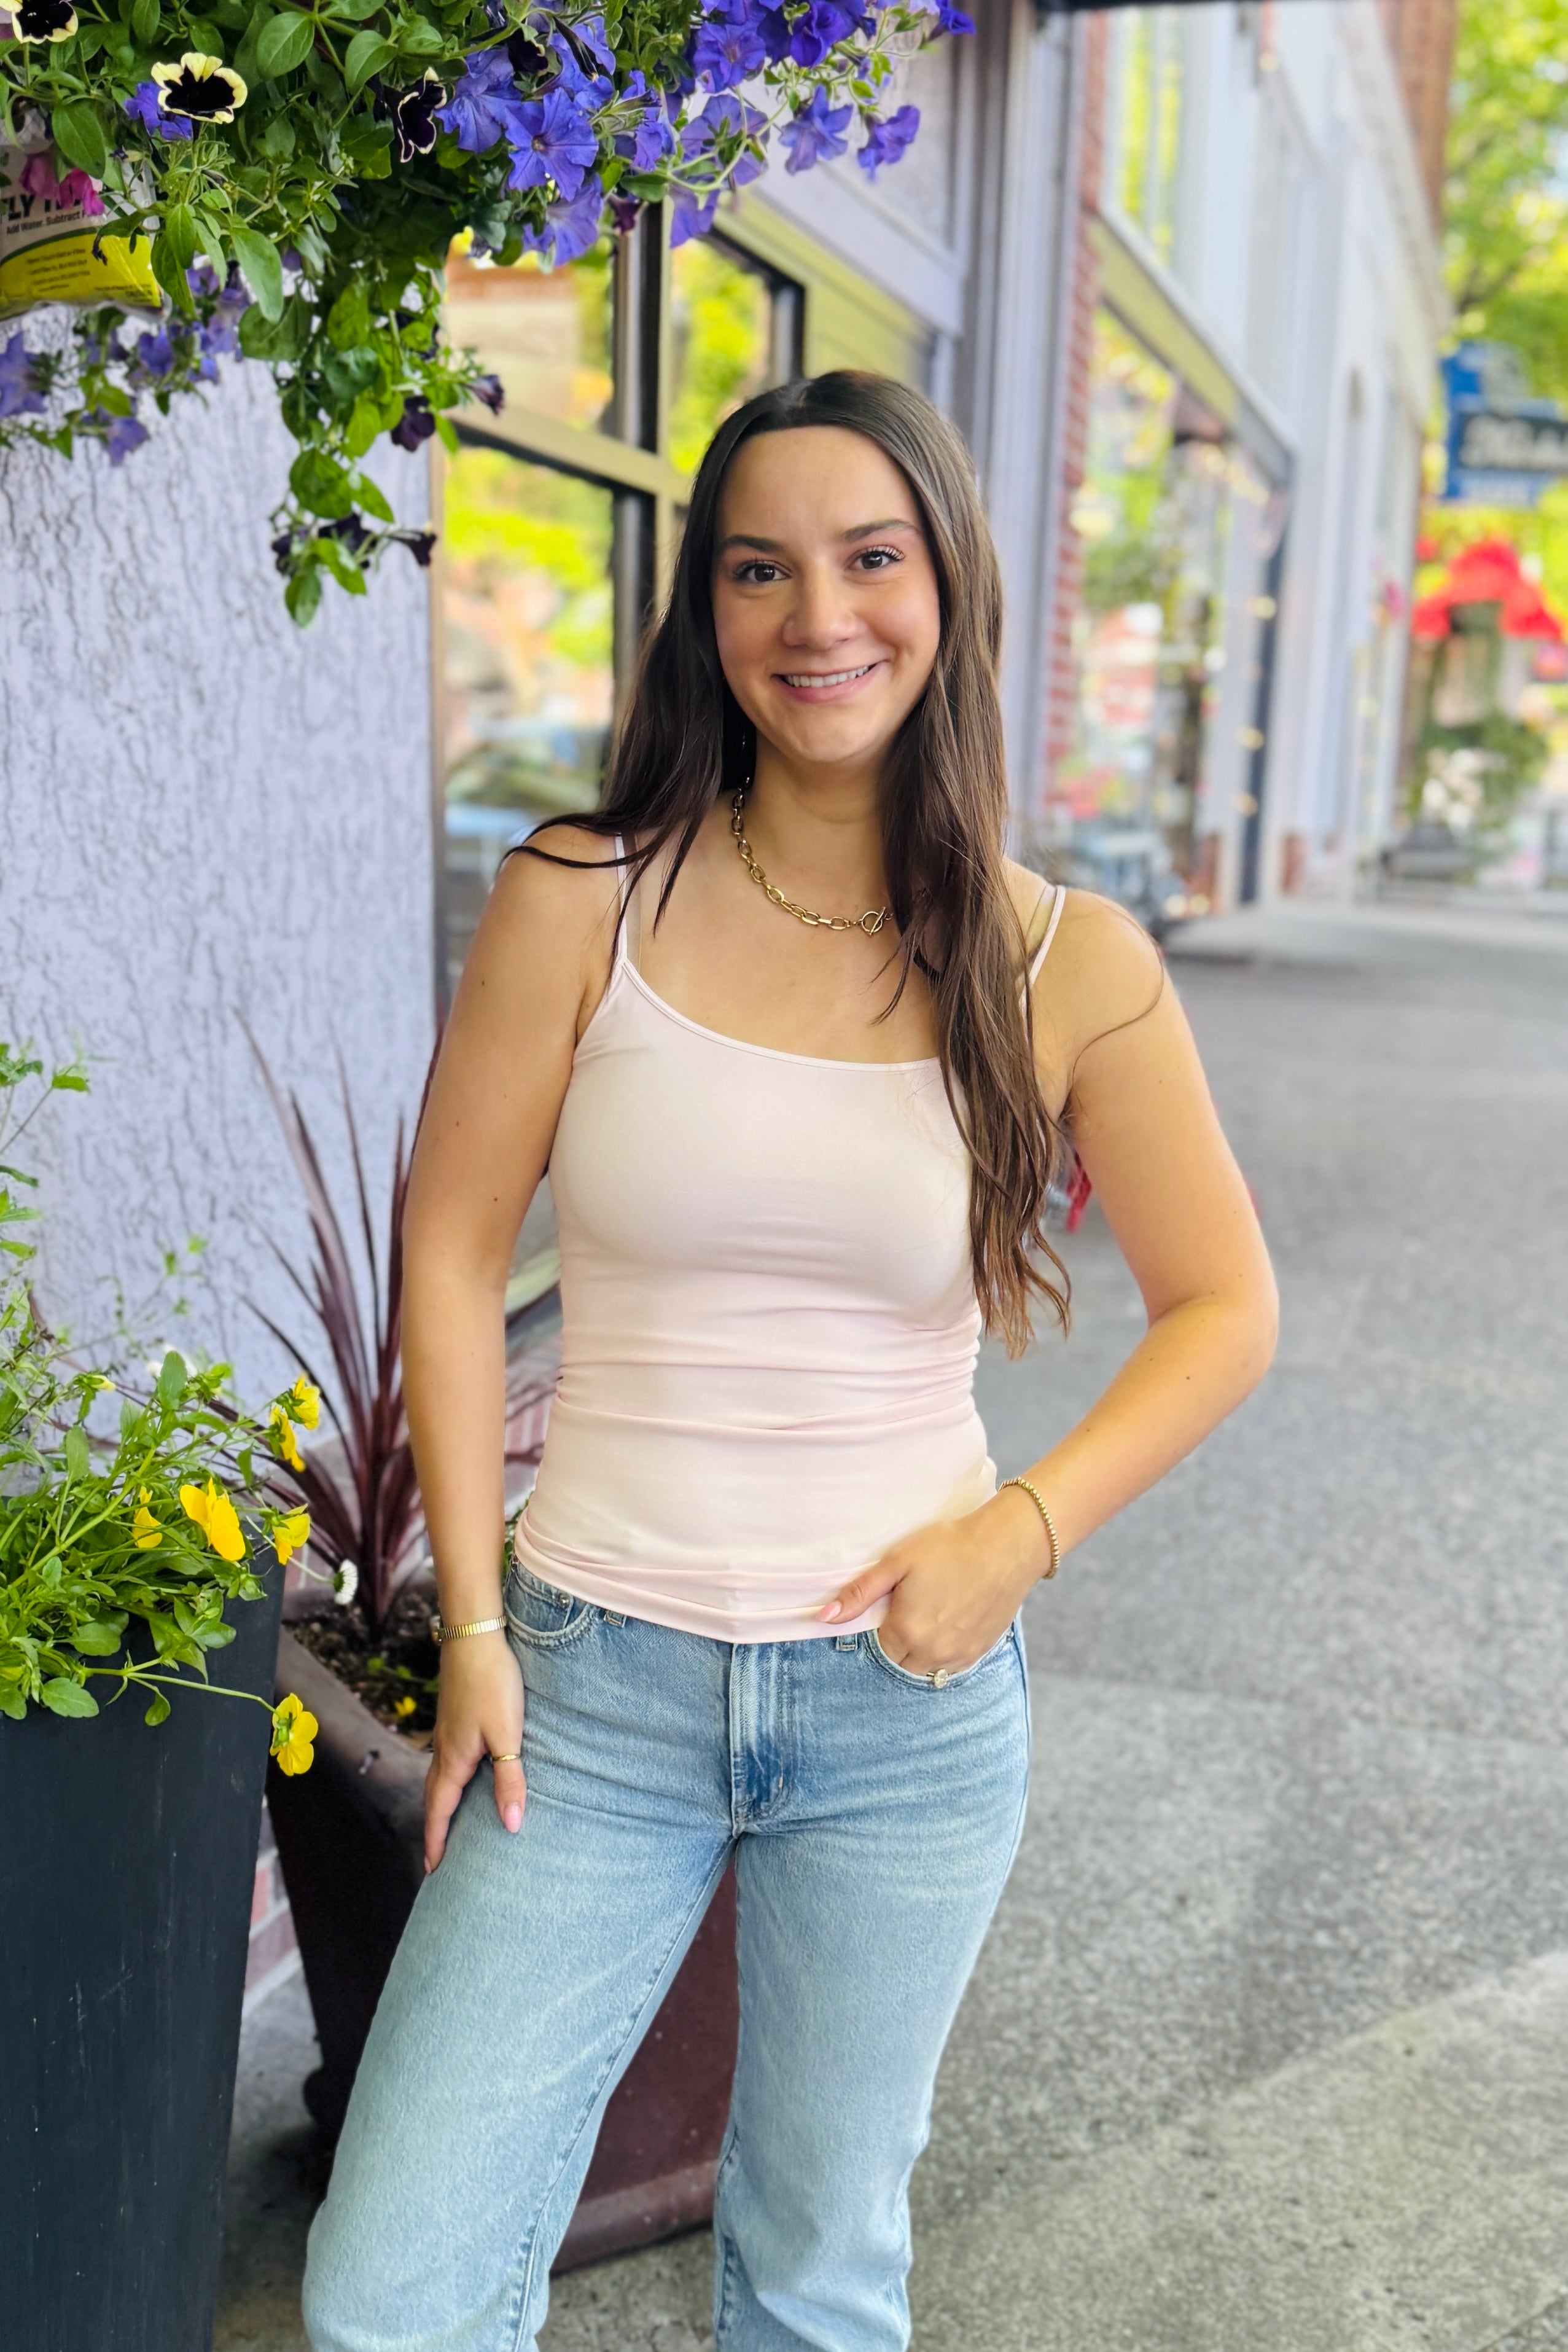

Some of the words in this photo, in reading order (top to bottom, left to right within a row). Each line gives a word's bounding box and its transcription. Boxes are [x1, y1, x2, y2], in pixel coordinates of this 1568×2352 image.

[0, 194, 36, 221] LY
[7, 223, 20, 234] Add
[46, 211, 80, 225] Subtract
